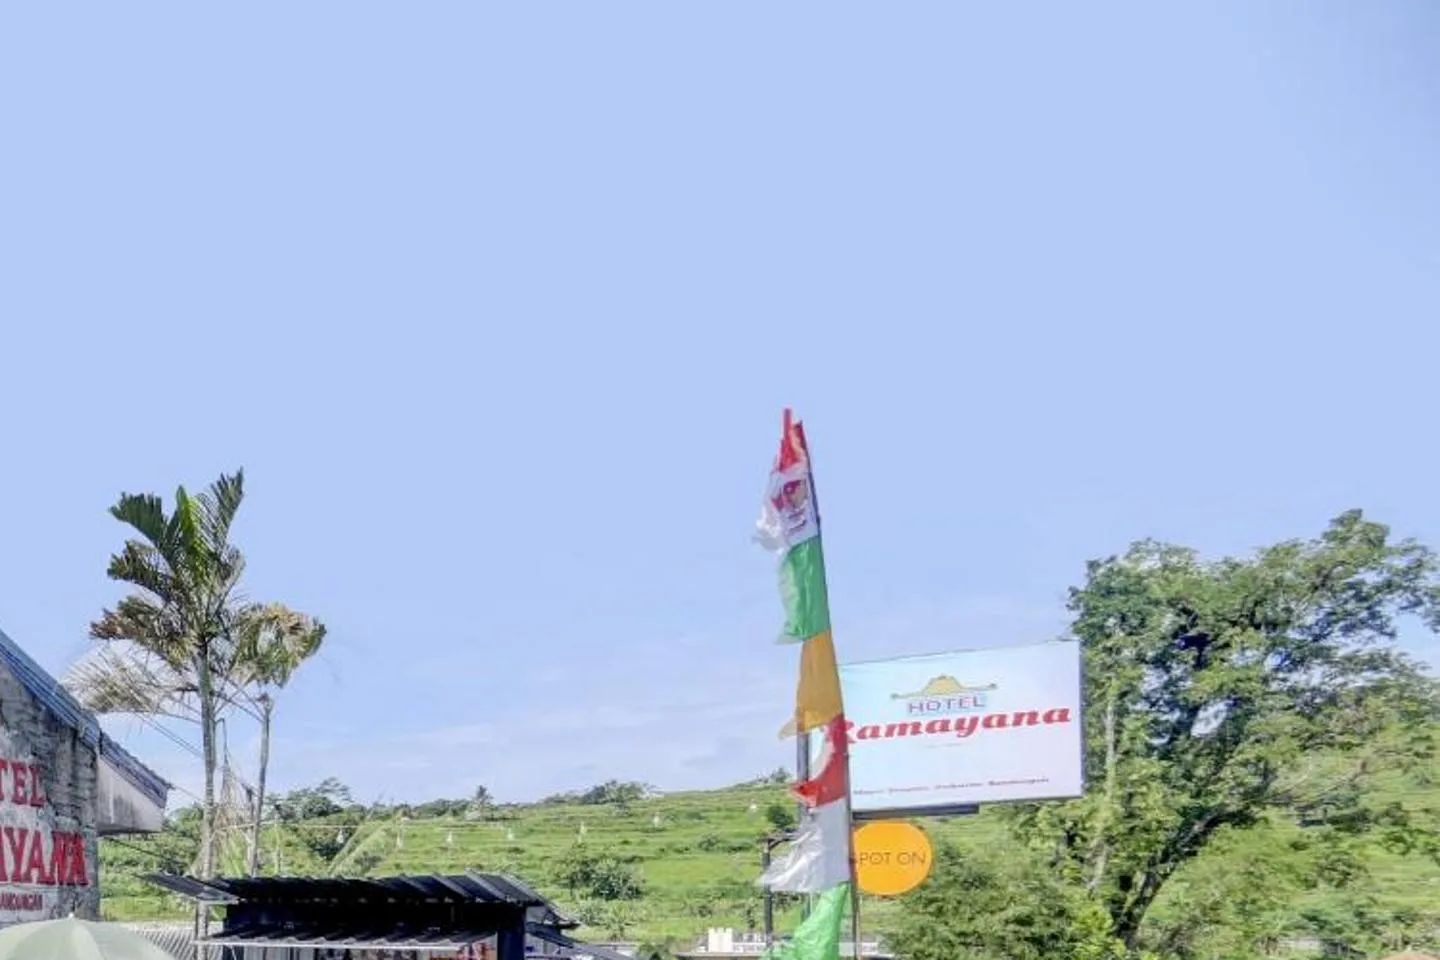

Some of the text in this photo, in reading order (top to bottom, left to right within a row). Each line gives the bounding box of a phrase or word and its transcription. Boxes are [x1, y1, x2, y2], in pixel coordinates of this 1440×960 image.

[909, 696, 985, 713] HOTEL
[851, 852, 926, 866] POT ON
